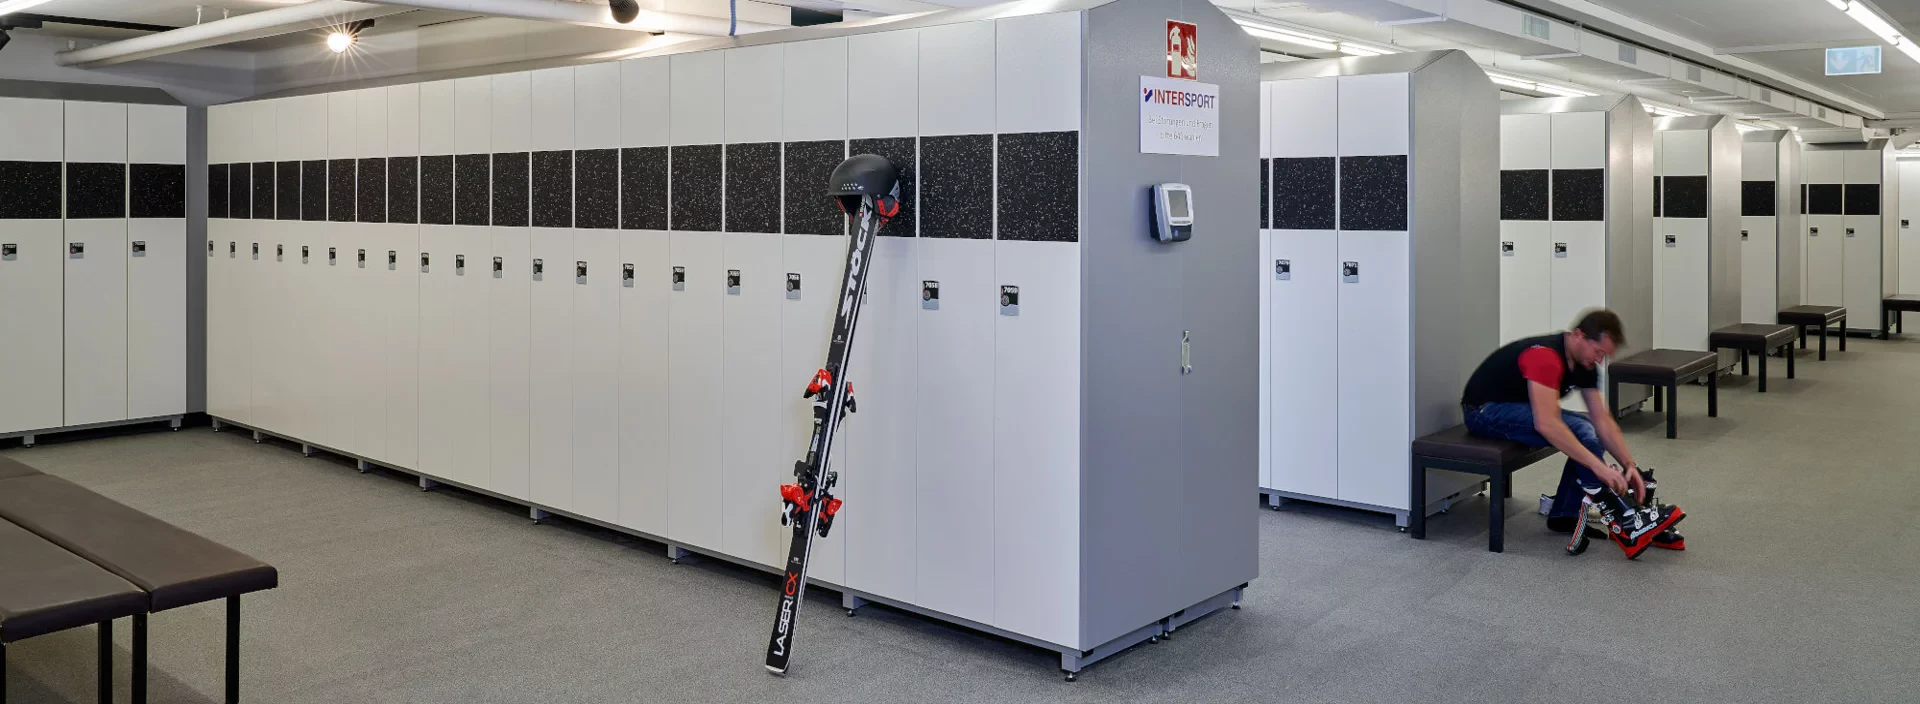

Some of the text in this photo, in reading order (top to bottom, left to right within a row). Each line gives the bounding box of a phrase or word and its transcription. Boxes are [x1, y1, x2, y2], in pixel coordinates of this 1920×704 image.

[1154, 89, 1215, 109] INTERSPORT
[773, 600, 794, 657] LASER
[785, 571, 799, 595] CX
